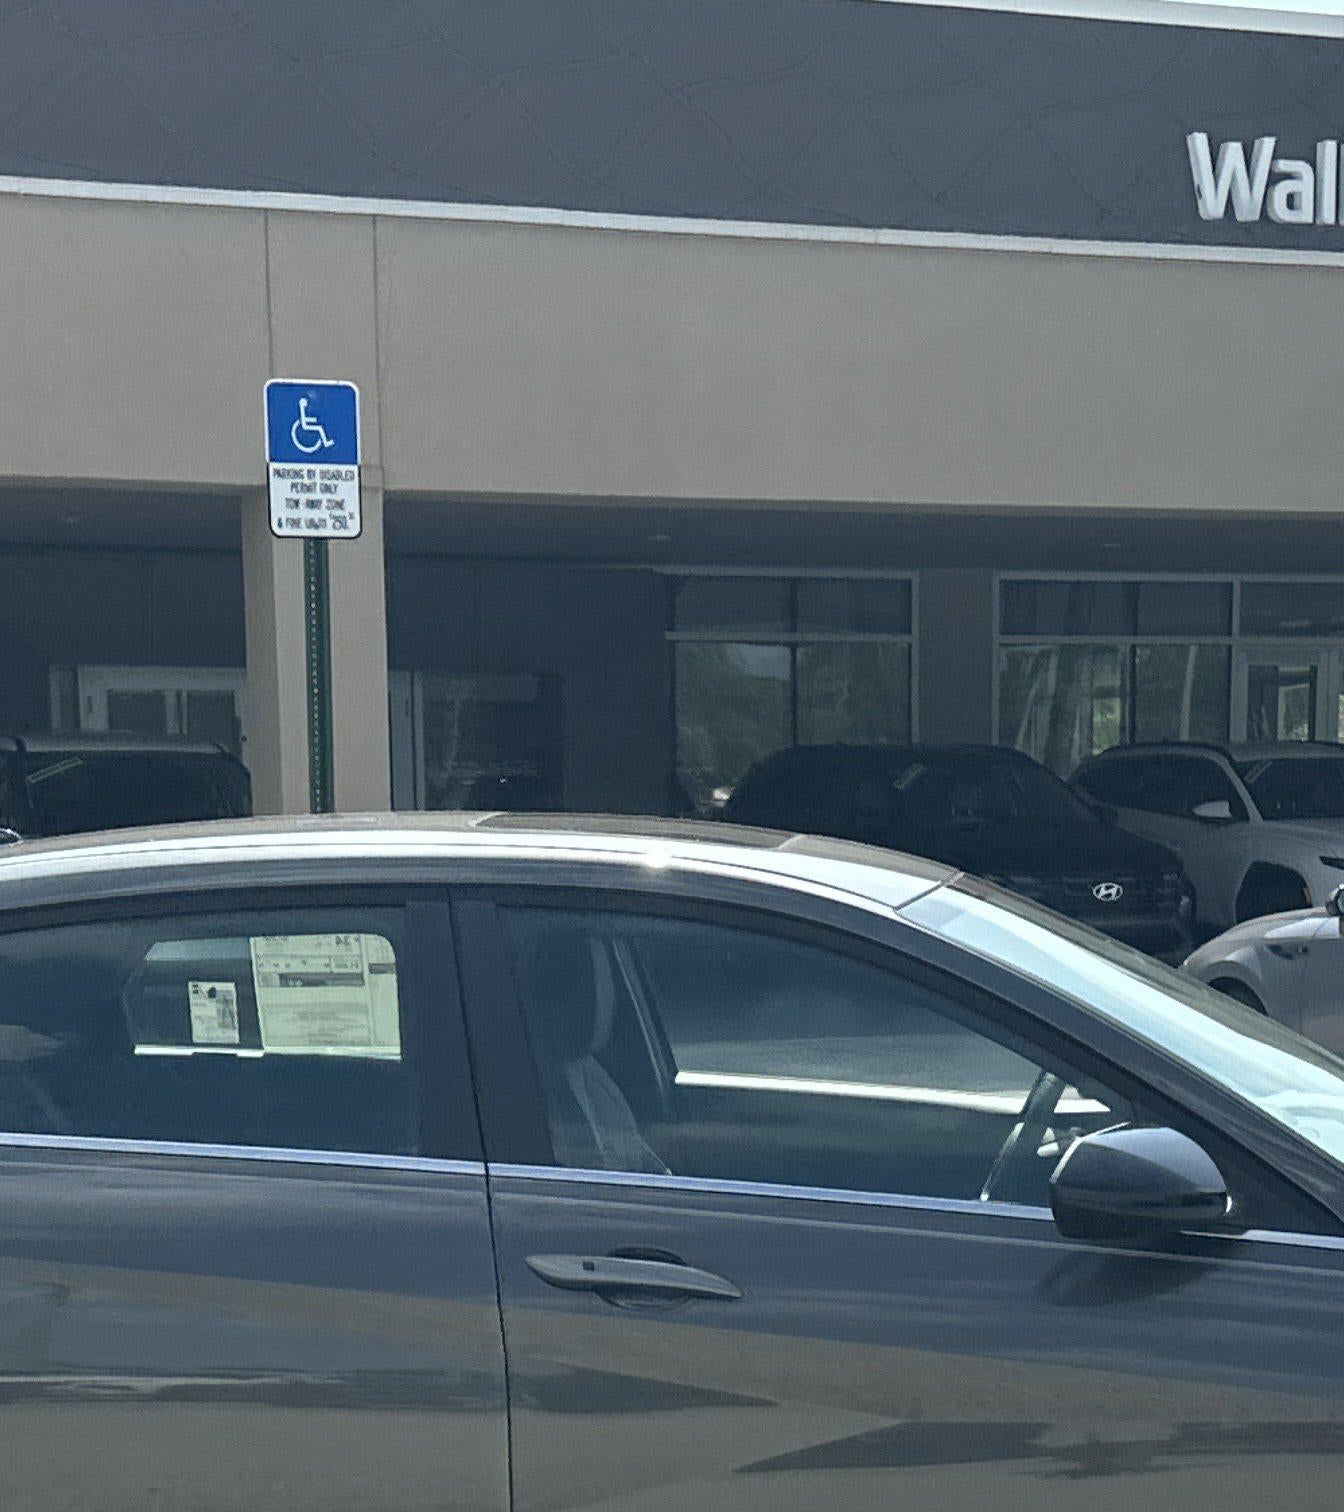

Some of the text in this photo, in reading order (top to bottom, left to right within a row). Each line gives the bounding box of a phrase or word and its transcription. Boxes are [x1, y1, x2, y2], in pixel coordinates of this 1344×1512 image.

[273, 468, 304, 480] PARKING
[319, 469, 355, 481] DISABLED
[290, 482, 338, 494] PERMIT ONLY
[285, 498, 300, 509] TOW
[326, 499, 345, 510] ZONE
